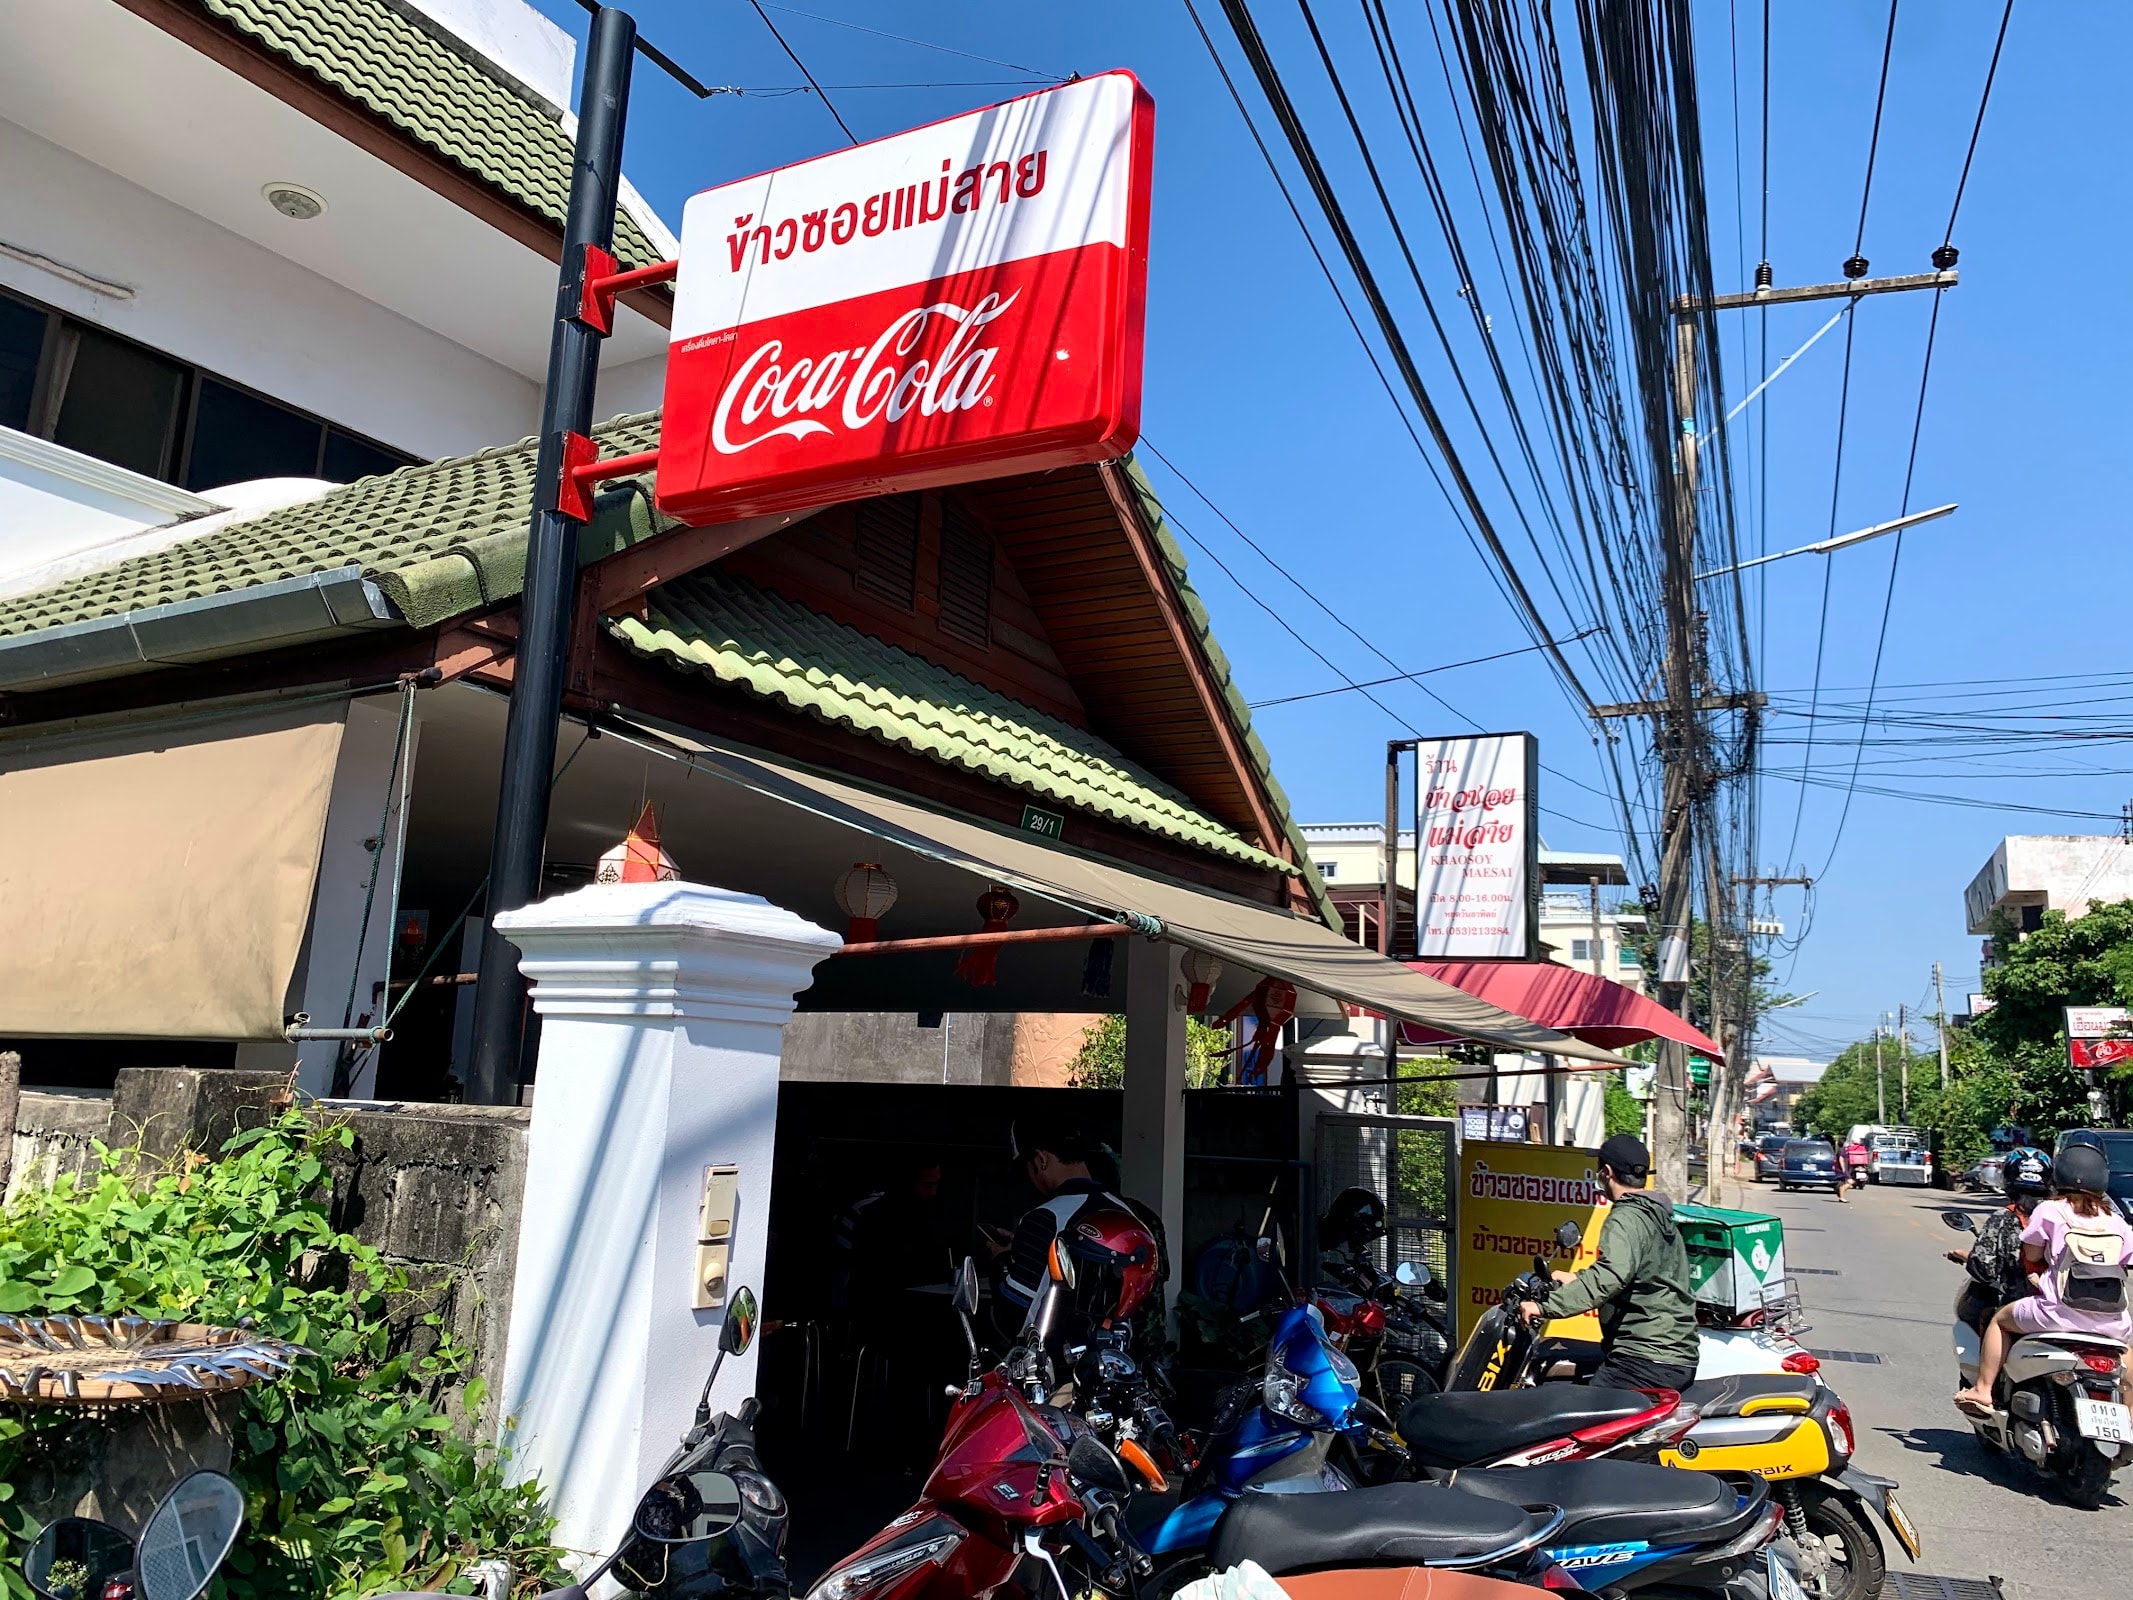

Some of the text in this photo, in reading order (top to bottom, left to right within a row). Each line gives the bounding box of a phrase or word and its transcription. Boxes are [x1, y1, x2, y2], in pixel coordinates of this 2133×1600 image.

[726, 150, 1048, 272] ข้าวซอยแม่สาย
[711, 286, 1022, 455] Coca-Cola
[1425, 754, 1458, 774] ร้าน
[1425, 784, 1516, 813] ข้าวซอย
[1030, 814, 1055, 835] 29/1
[1428, 818, 1514, 850] แม่สาย
[1430, 854, 1493, 866] KHAOSOY
[1462, 867, 1513, 879] MAESAI
[1465, 1118, 1497, 1126] YOGUT
[2095, 1426, 2121, 1439] 150
